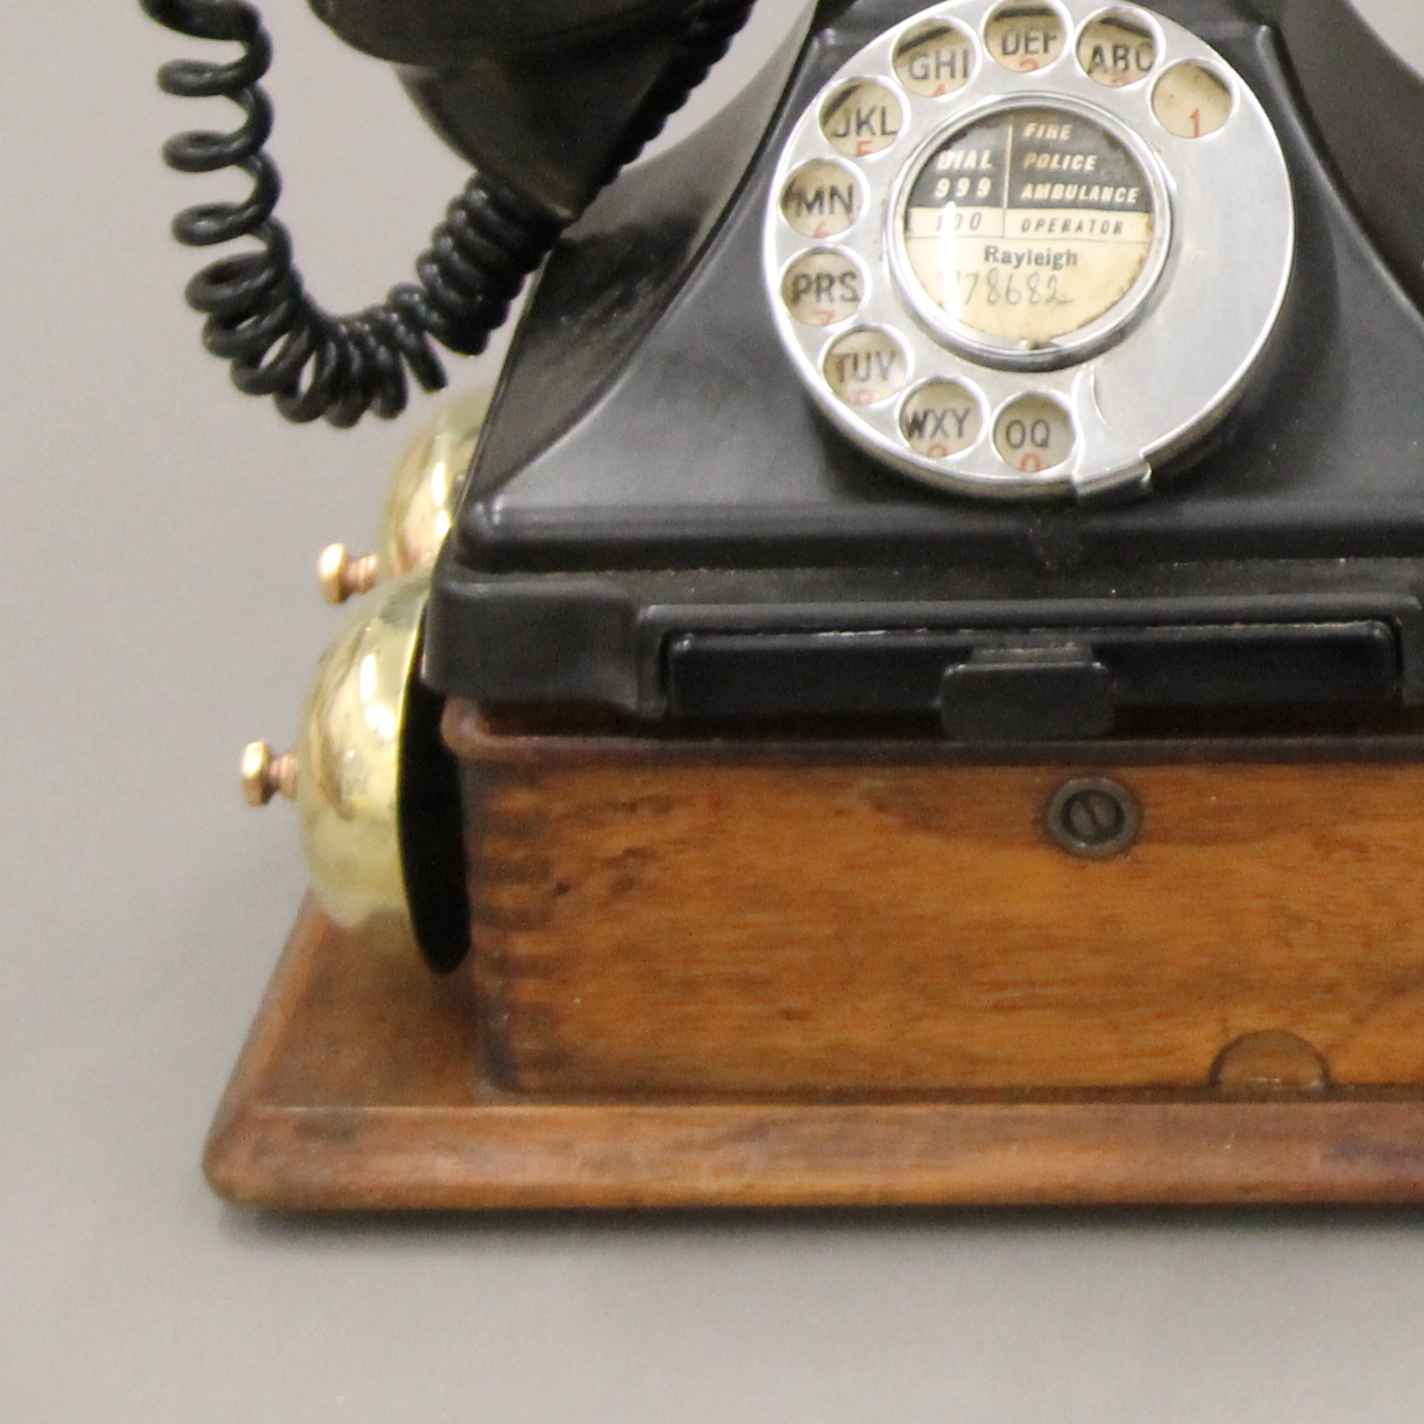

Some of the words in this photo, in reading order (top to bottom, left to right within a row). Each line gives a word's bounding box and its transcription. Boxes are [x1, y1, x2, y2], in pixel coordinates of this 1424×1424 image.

[908, 48, 970, 81] GHI
[1088, 42, 1152, 74] ABC
[834, 105, 899, 138] JKL
[1023, 123, 1073, 140] FIRE
[937, 150, 994, 170] DIAL
[1023, 152, 1098, 172] POLICE
[796, 184, 854, 217] MN
[935, 176, 992, 199] 999
[1021, 182, 1140, 204] AMBULANCE
[1021, 217, 1124, 235] OPERATOR
[983, 245, 1078, 269] Rayleigh
[790, 271, 860, 305] PRS
[833, 350, 897, 383] TUV
[906, 407, 971, 440] WXY
[1005, 418, 1051, 450] OQ
